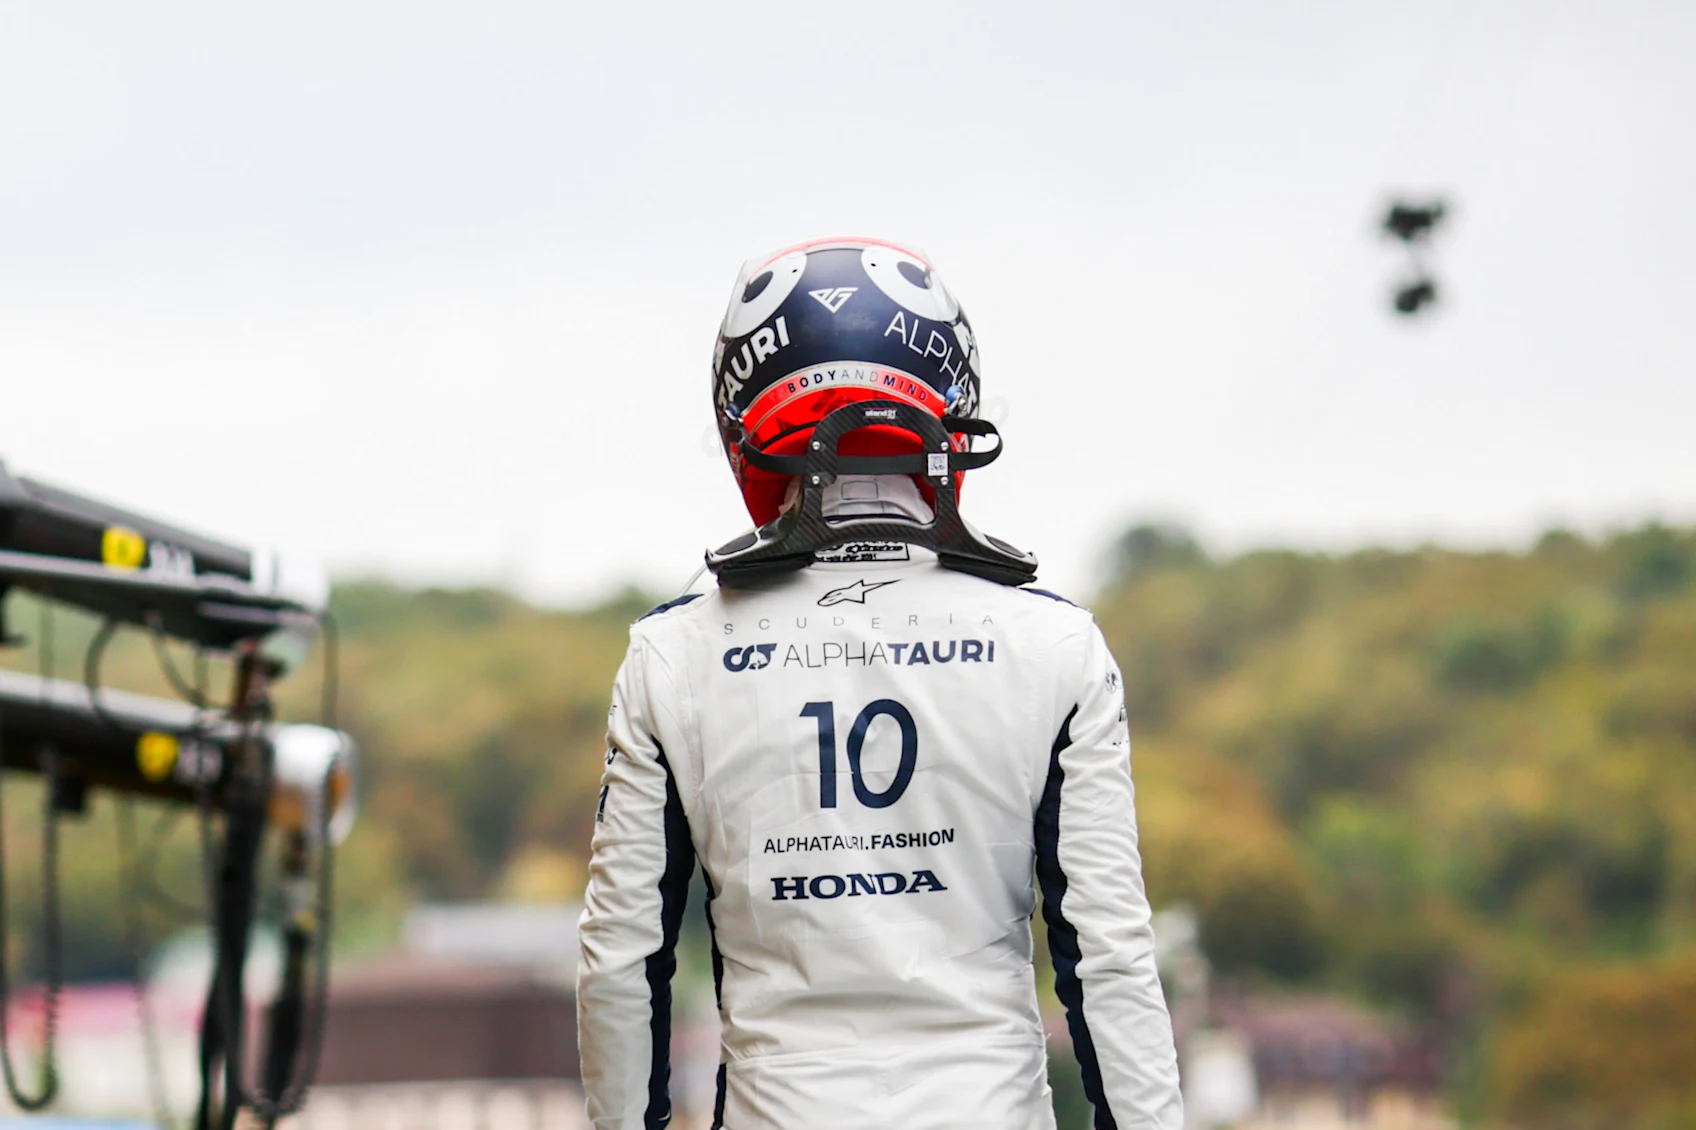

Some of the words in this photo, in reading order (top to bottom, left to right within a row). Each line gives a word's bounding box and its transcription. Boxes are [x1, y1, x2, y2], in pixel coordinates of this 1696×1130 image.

[723, 612, 994, 635] SCUDERIA
[782, 639, 996, 669] ALPHATAURI
[798, 698, 918, 809] 10
[763, 828, 955, 854] ALPHATAURI.FASHION
[770, 869, 949, 901] HONDA
